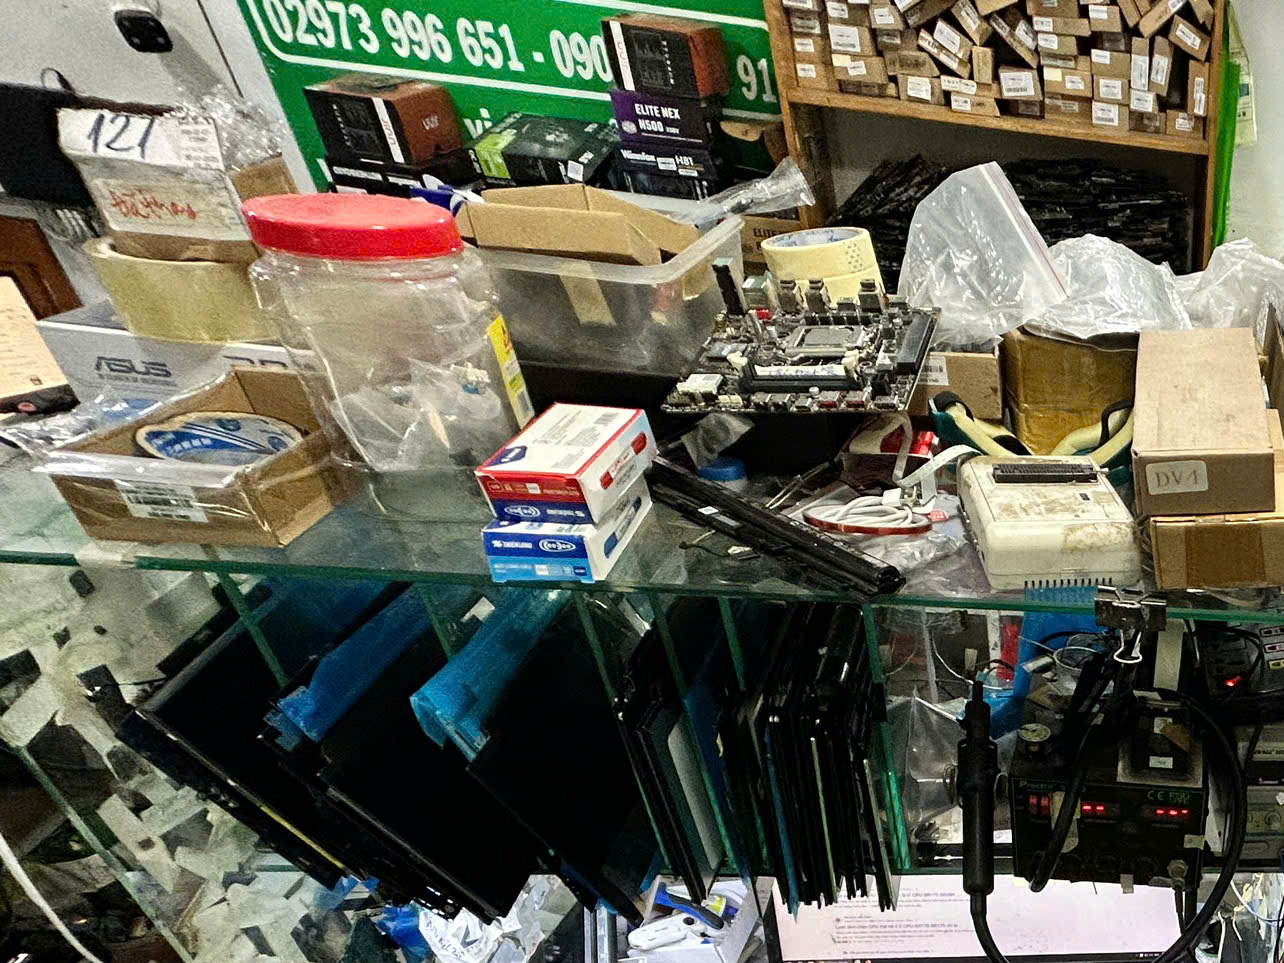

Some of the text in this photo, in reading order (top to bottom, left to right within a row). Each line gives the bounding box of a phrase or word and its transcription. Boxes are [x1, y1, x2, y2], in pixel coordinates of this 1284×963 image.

[262, 0, 380, 54] 02973
[381, 7, 453, 63] 996
[456, 17, 525, 72] 651
[634, 103, 681, 120] ELITE NEX
[638, 119, 664, 133] N500
[95, 355, 172, 378] ASUS
